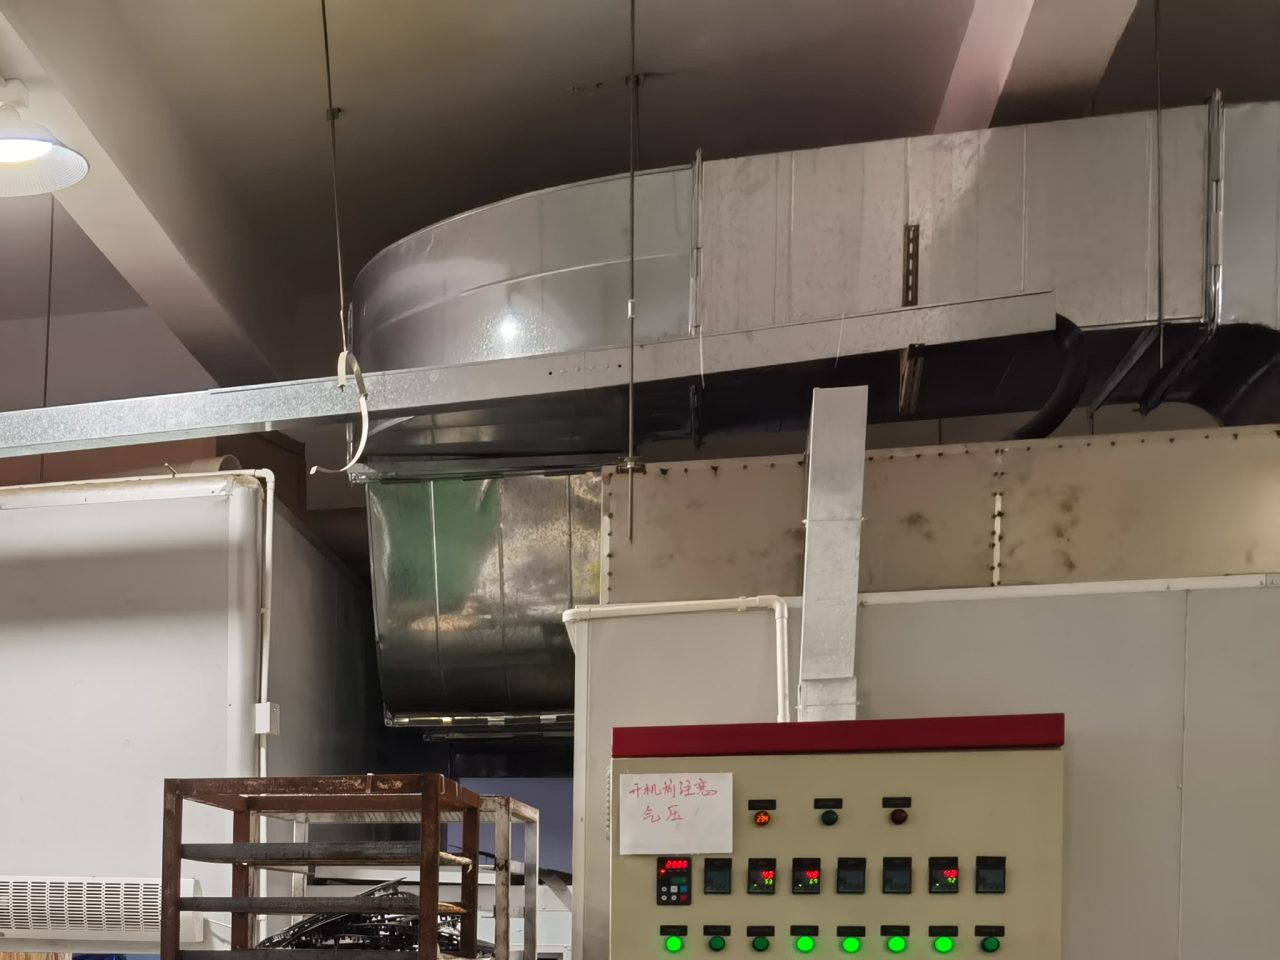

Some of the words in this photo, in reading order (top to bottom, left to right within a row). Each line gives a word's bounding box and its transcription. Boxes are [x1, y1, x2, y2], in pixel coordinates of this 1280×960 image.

[628, 778, 718, 798] 开机前注意
[642, 804, 684, 822] 气压
